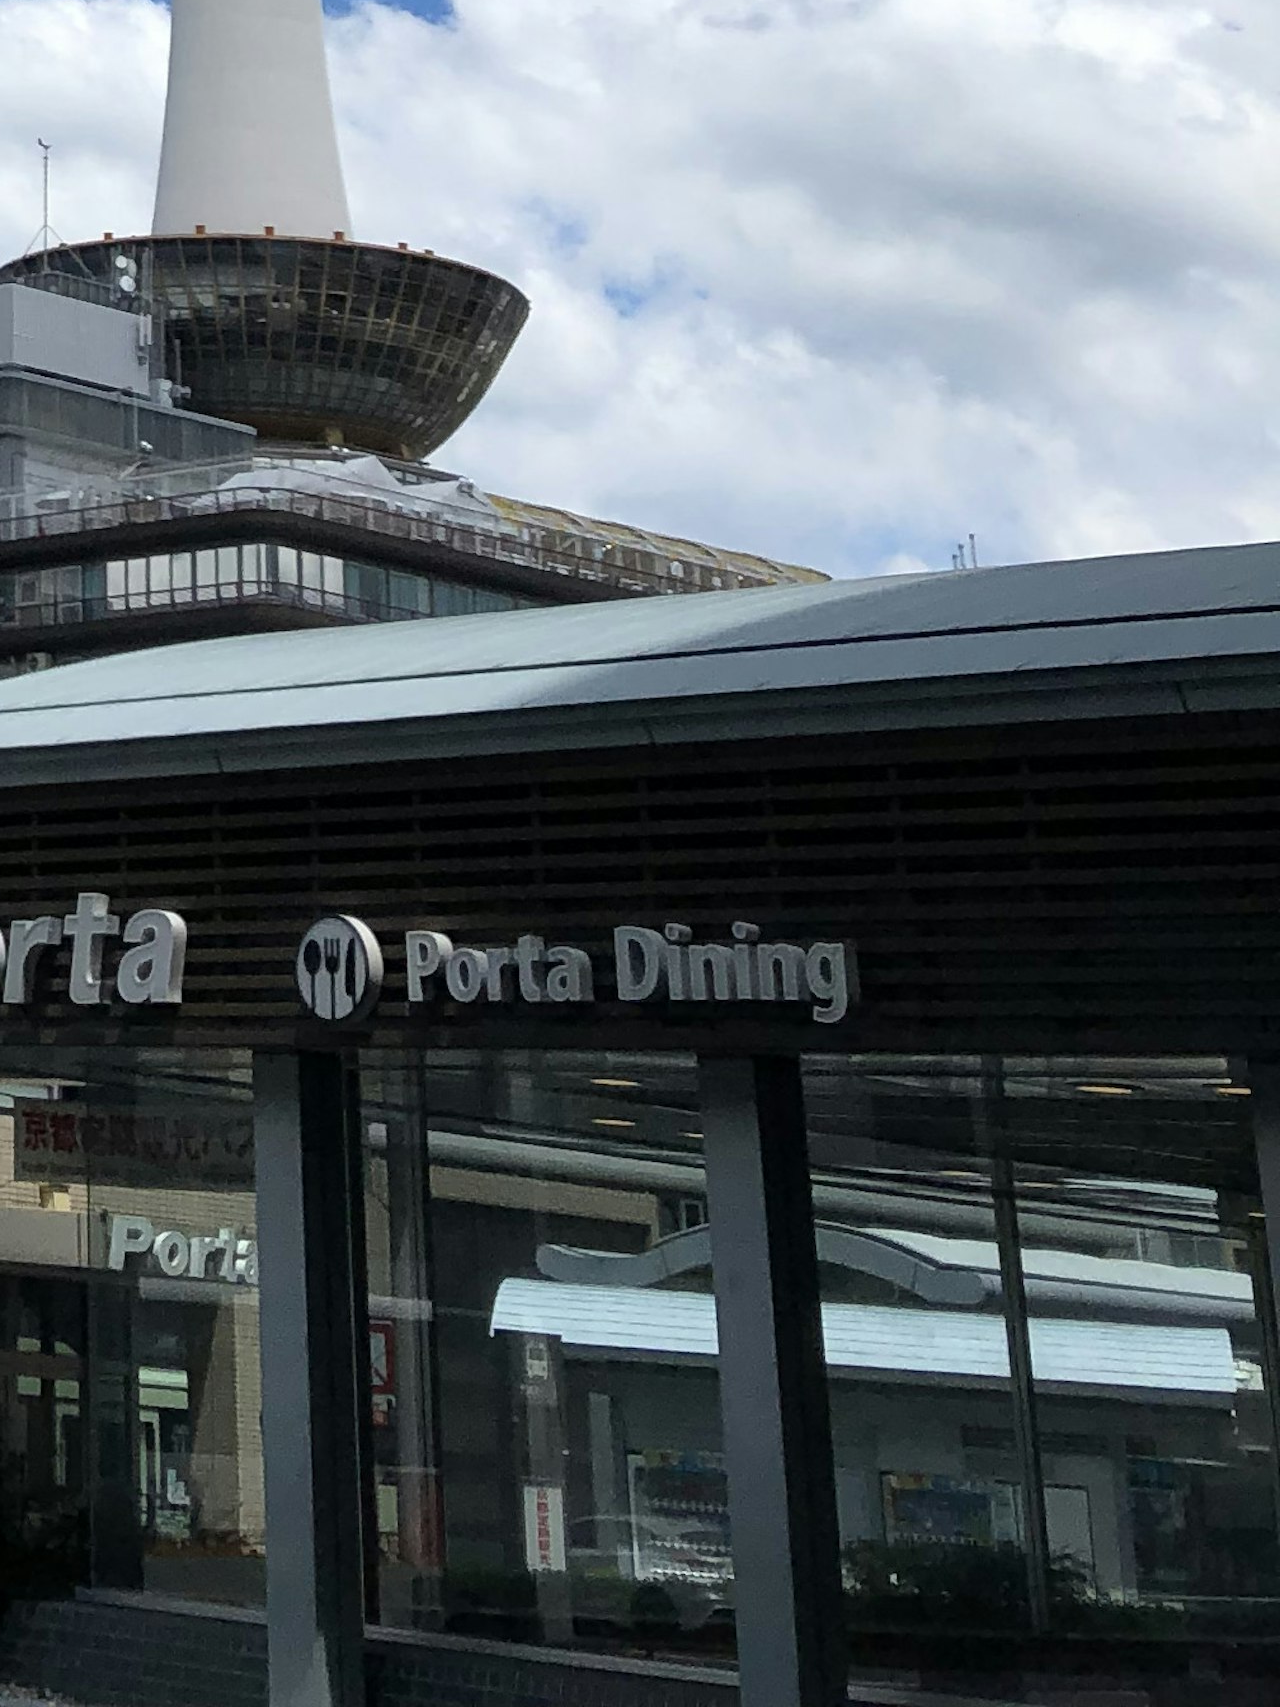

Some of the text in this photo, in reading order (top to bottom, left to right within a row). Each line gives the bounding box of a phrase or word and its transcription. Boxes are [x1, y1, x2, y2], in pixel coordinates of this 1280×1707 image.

[405, 921, 858, 1024] Porta Dining
[108, 1215, 259, 1285] Porta
